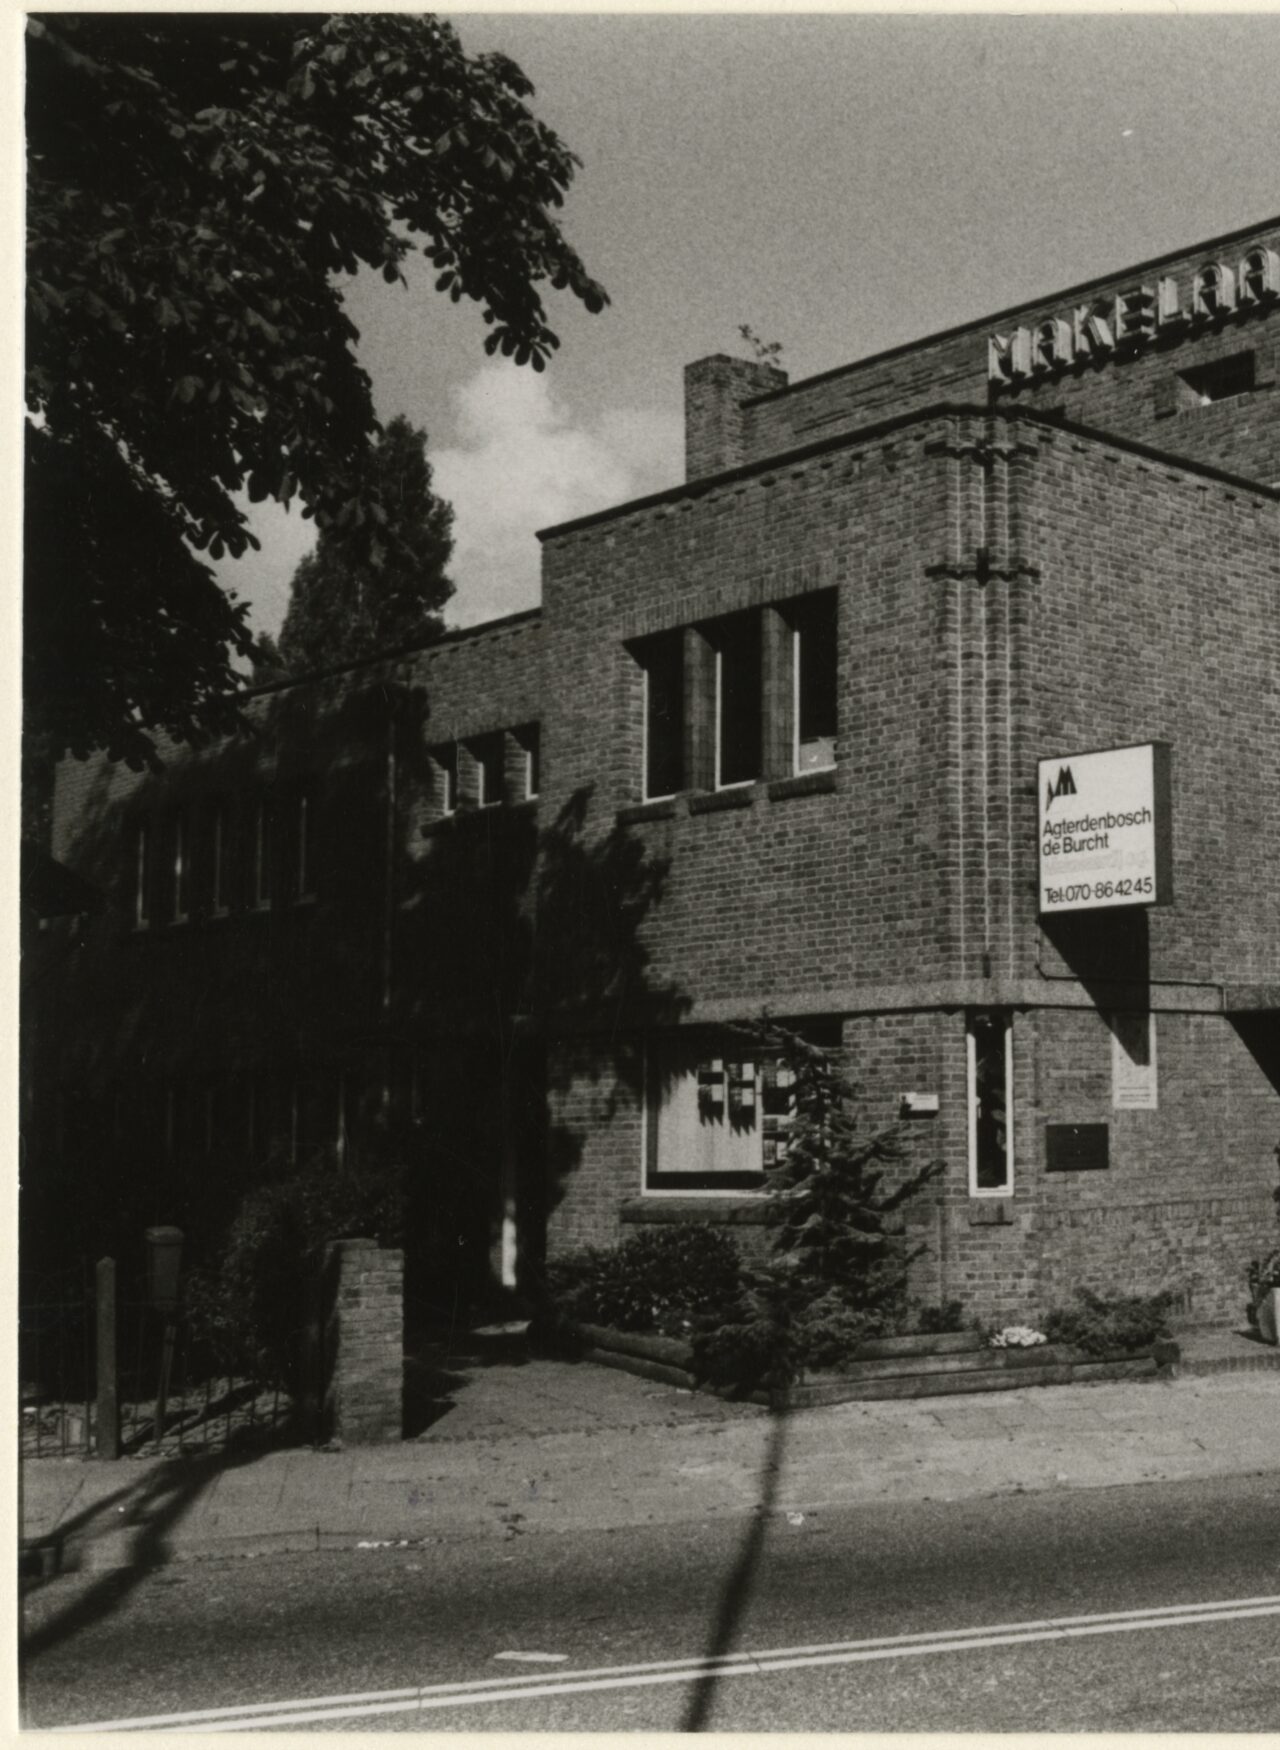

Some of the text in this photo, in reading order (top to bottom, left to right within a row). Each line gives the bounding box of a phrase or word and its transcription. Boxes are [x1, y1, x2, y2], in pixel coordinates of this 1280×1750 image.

[1043, 807, 1151, 839] Agterdenbosch
[1043, 832, 1109, 856] de Burcht
